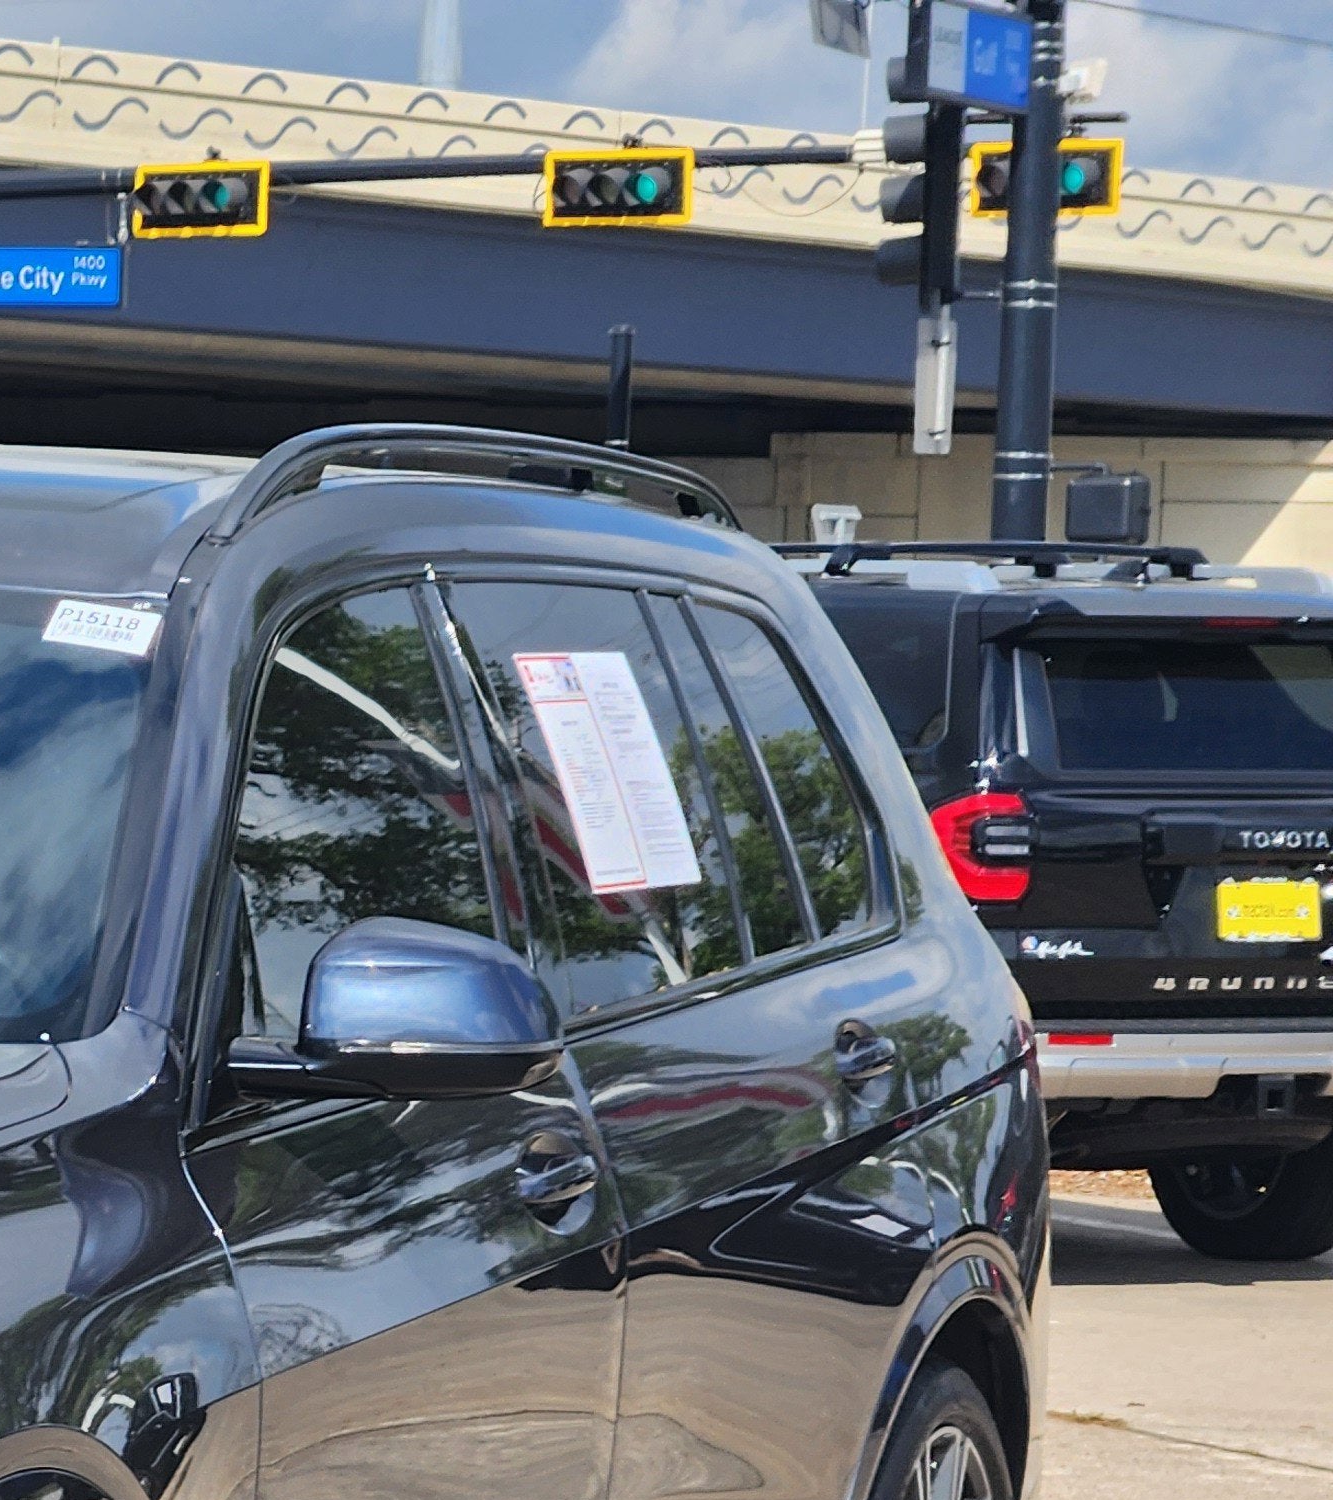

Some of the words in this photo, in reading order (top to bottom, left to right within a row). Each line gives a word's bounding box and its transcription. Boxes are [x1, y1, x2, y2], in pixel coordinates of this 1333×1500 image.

[18, 264, 66, 295] City
[73, 254, 106, 270] 1400
[58, 607, 141, 631] P15118
[1239, 830, 1331, 849] TOYOTA
